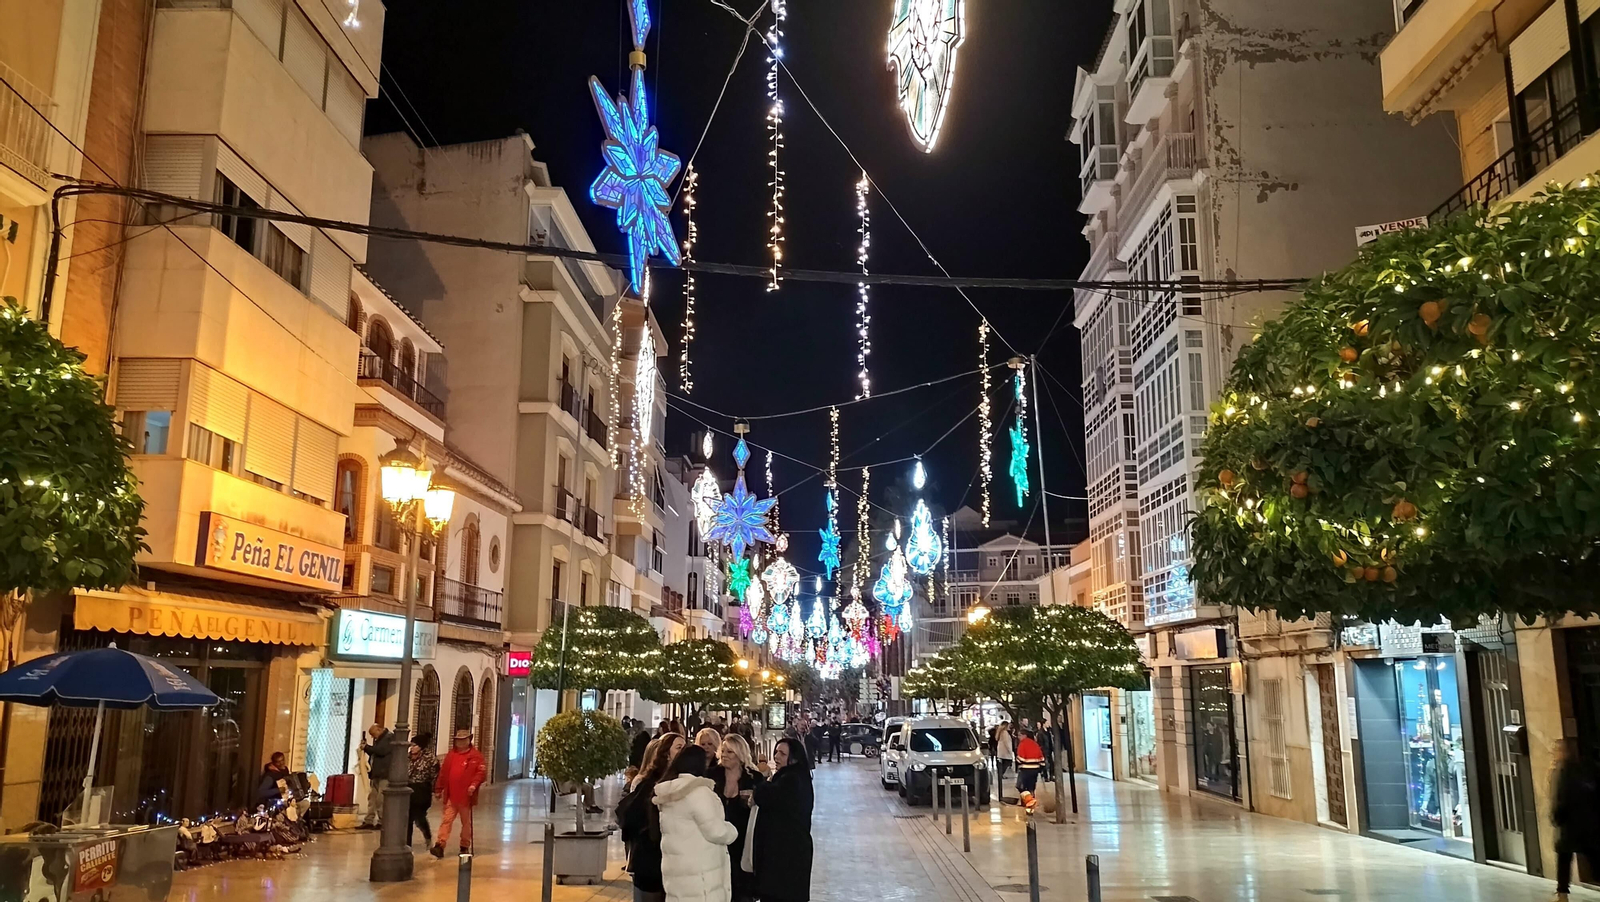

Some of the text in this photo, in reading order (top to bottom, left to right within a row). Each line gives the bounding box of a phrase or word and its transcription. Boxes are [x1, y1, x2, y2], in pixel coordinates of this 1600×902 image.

[1379, 218, 1423, 232] VENDE
[231, 532, 341, 584] Peña EL GENIL
[128, 606, 203, 634] PEÑA
[224, 616, 297, 640] GENIL
[361, 618, 402, 644] Carmen
[80, 851, 116, 873] CALIENTE
